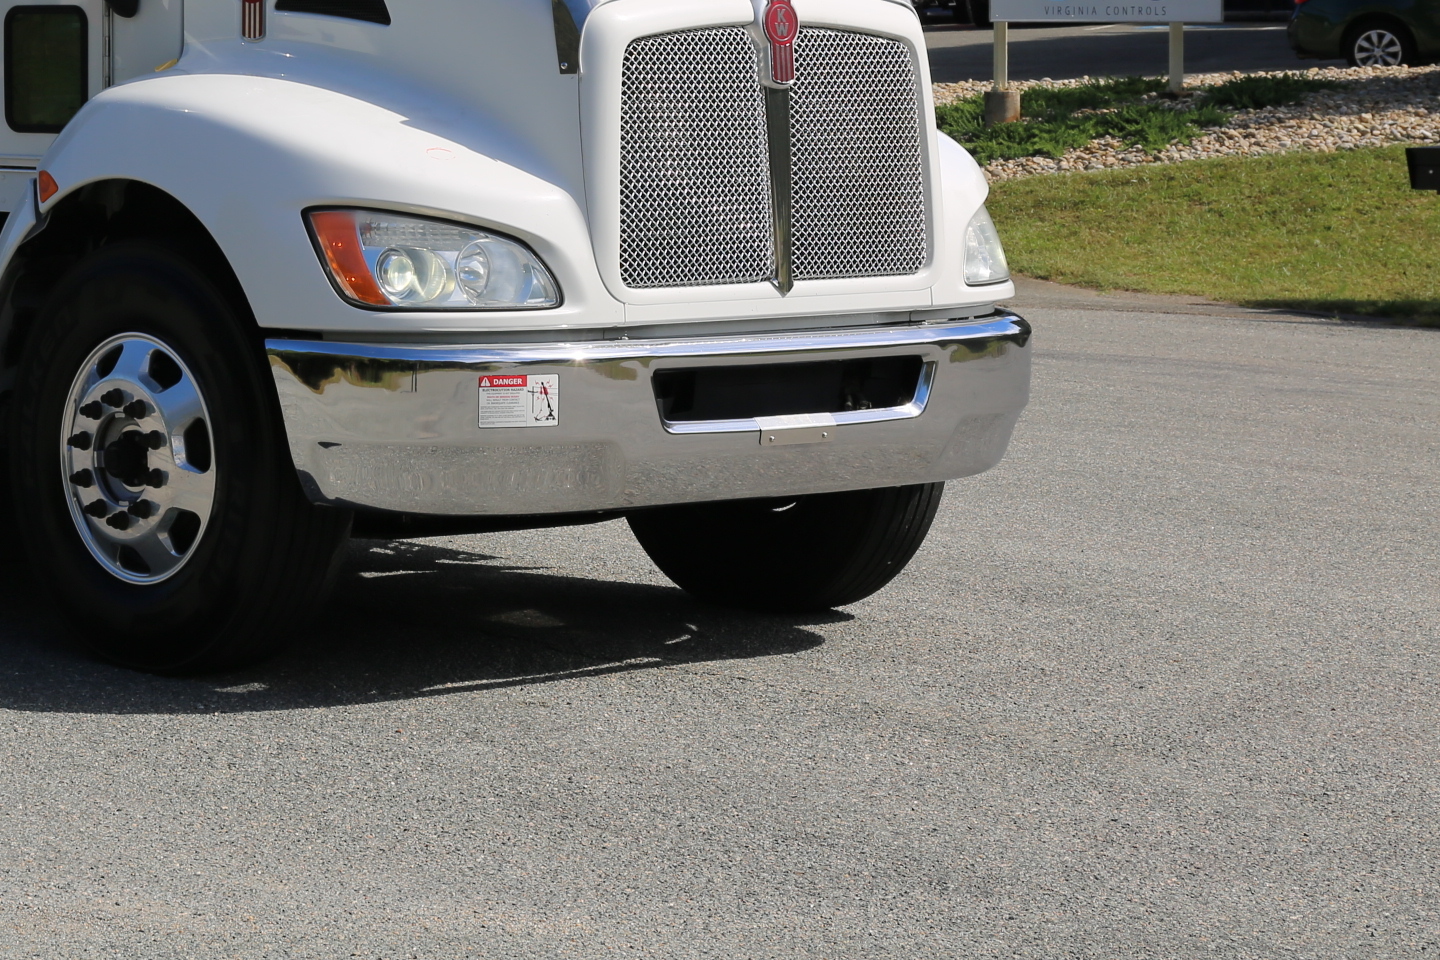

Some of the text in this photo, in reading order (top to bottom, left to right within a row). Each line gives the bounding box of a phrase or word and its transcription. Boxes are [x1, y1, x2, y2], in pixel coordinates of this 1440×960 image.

[777, 8, 787, 22] K
[1044, 5, 1167, 16] VIRGINIA CONTROLS
[774, 22, 789, 37] W
